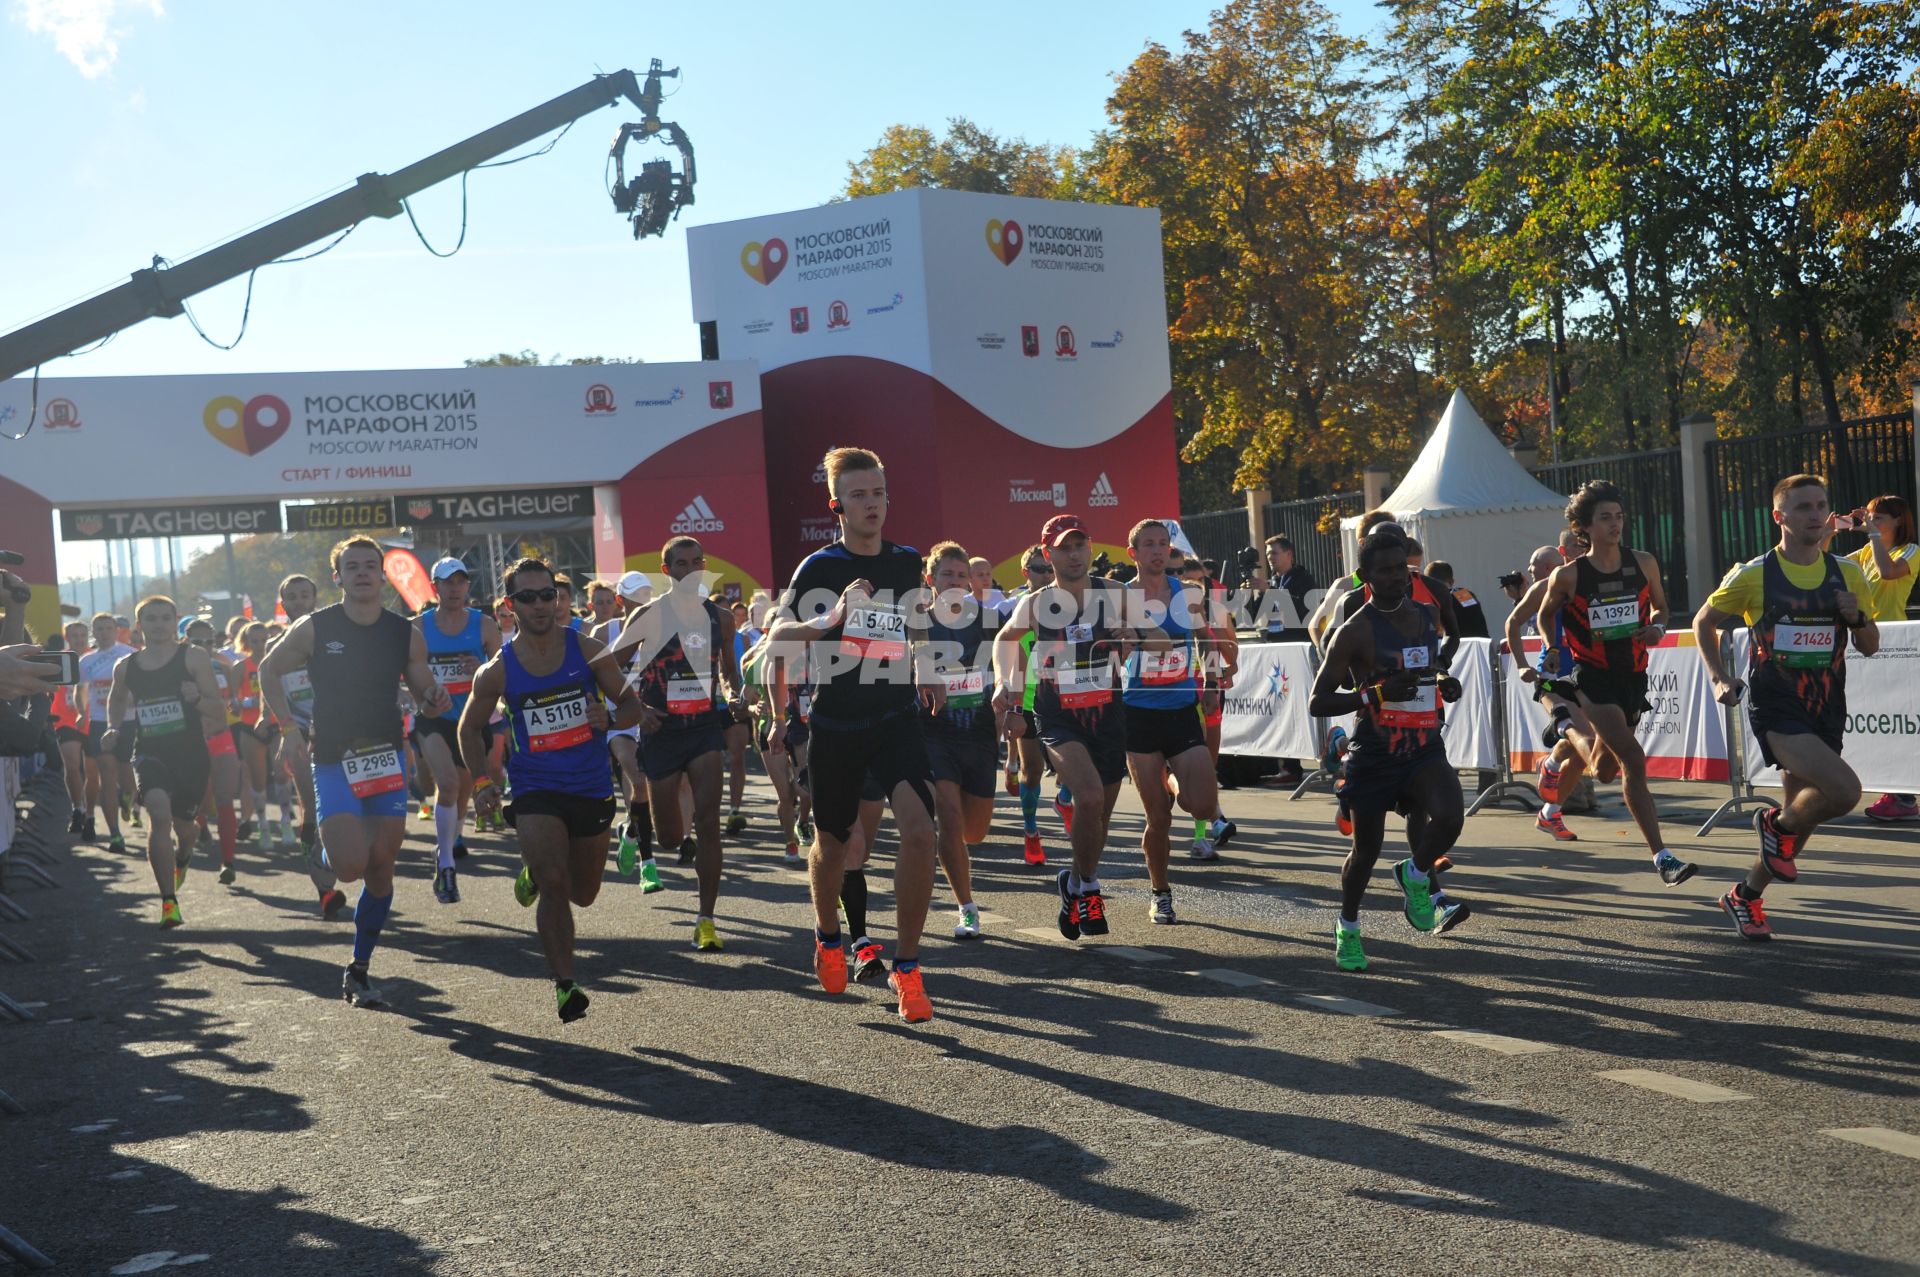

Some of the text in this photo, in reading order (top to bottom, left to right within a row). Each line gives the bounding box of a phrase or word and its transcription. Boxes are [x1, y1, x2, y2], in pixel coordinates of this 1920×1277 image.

[795, 217, 891, 251] МОСКОВСКИЙ
[1028, 224, 1103, 242] МОСКОВСКИЙ
[796, 238, 892, 268] МАРАФОН 2015
[1029, 241, 1104, 259] МАРАФОН 2015
[798, 257, 893, 282] MOSCOW MARATHON
[1031, 259, 1104, 272] MOSCOW MARATHON
[304, 389, 476, 414] МОСКОВСКИЙ
[306, 414, 478, 436] МАРАФОН 2015
[308, 437, 478, 455] MOSCOW MARATHON
[281, 467, 332, 482] СТАРТ
[345, 465, 412, 479] ФИНИШ
[1009, 487, 1052, 502] Москва
[1088, 495, 1118, 507] adidas
[670, 518, 725, 533] adidas
[1592, 604, 1635, 620] A 13921
[848, 611, 902, 632] A 5402
[1793, 632, 1832, 646] 21426
[1074, 675, 1099, 684] БЫКОВ
[1648, 670, 1678, 692] КИЙ
[150, 704, 179, 717] 15416
[531, 701, 582, 726] A 5118
[1224, 698, 1272, 716] ЛУЖНИКИ
[1654, 697, 1680, 715] 2015
[346, 753, 396, 775] B 2985
